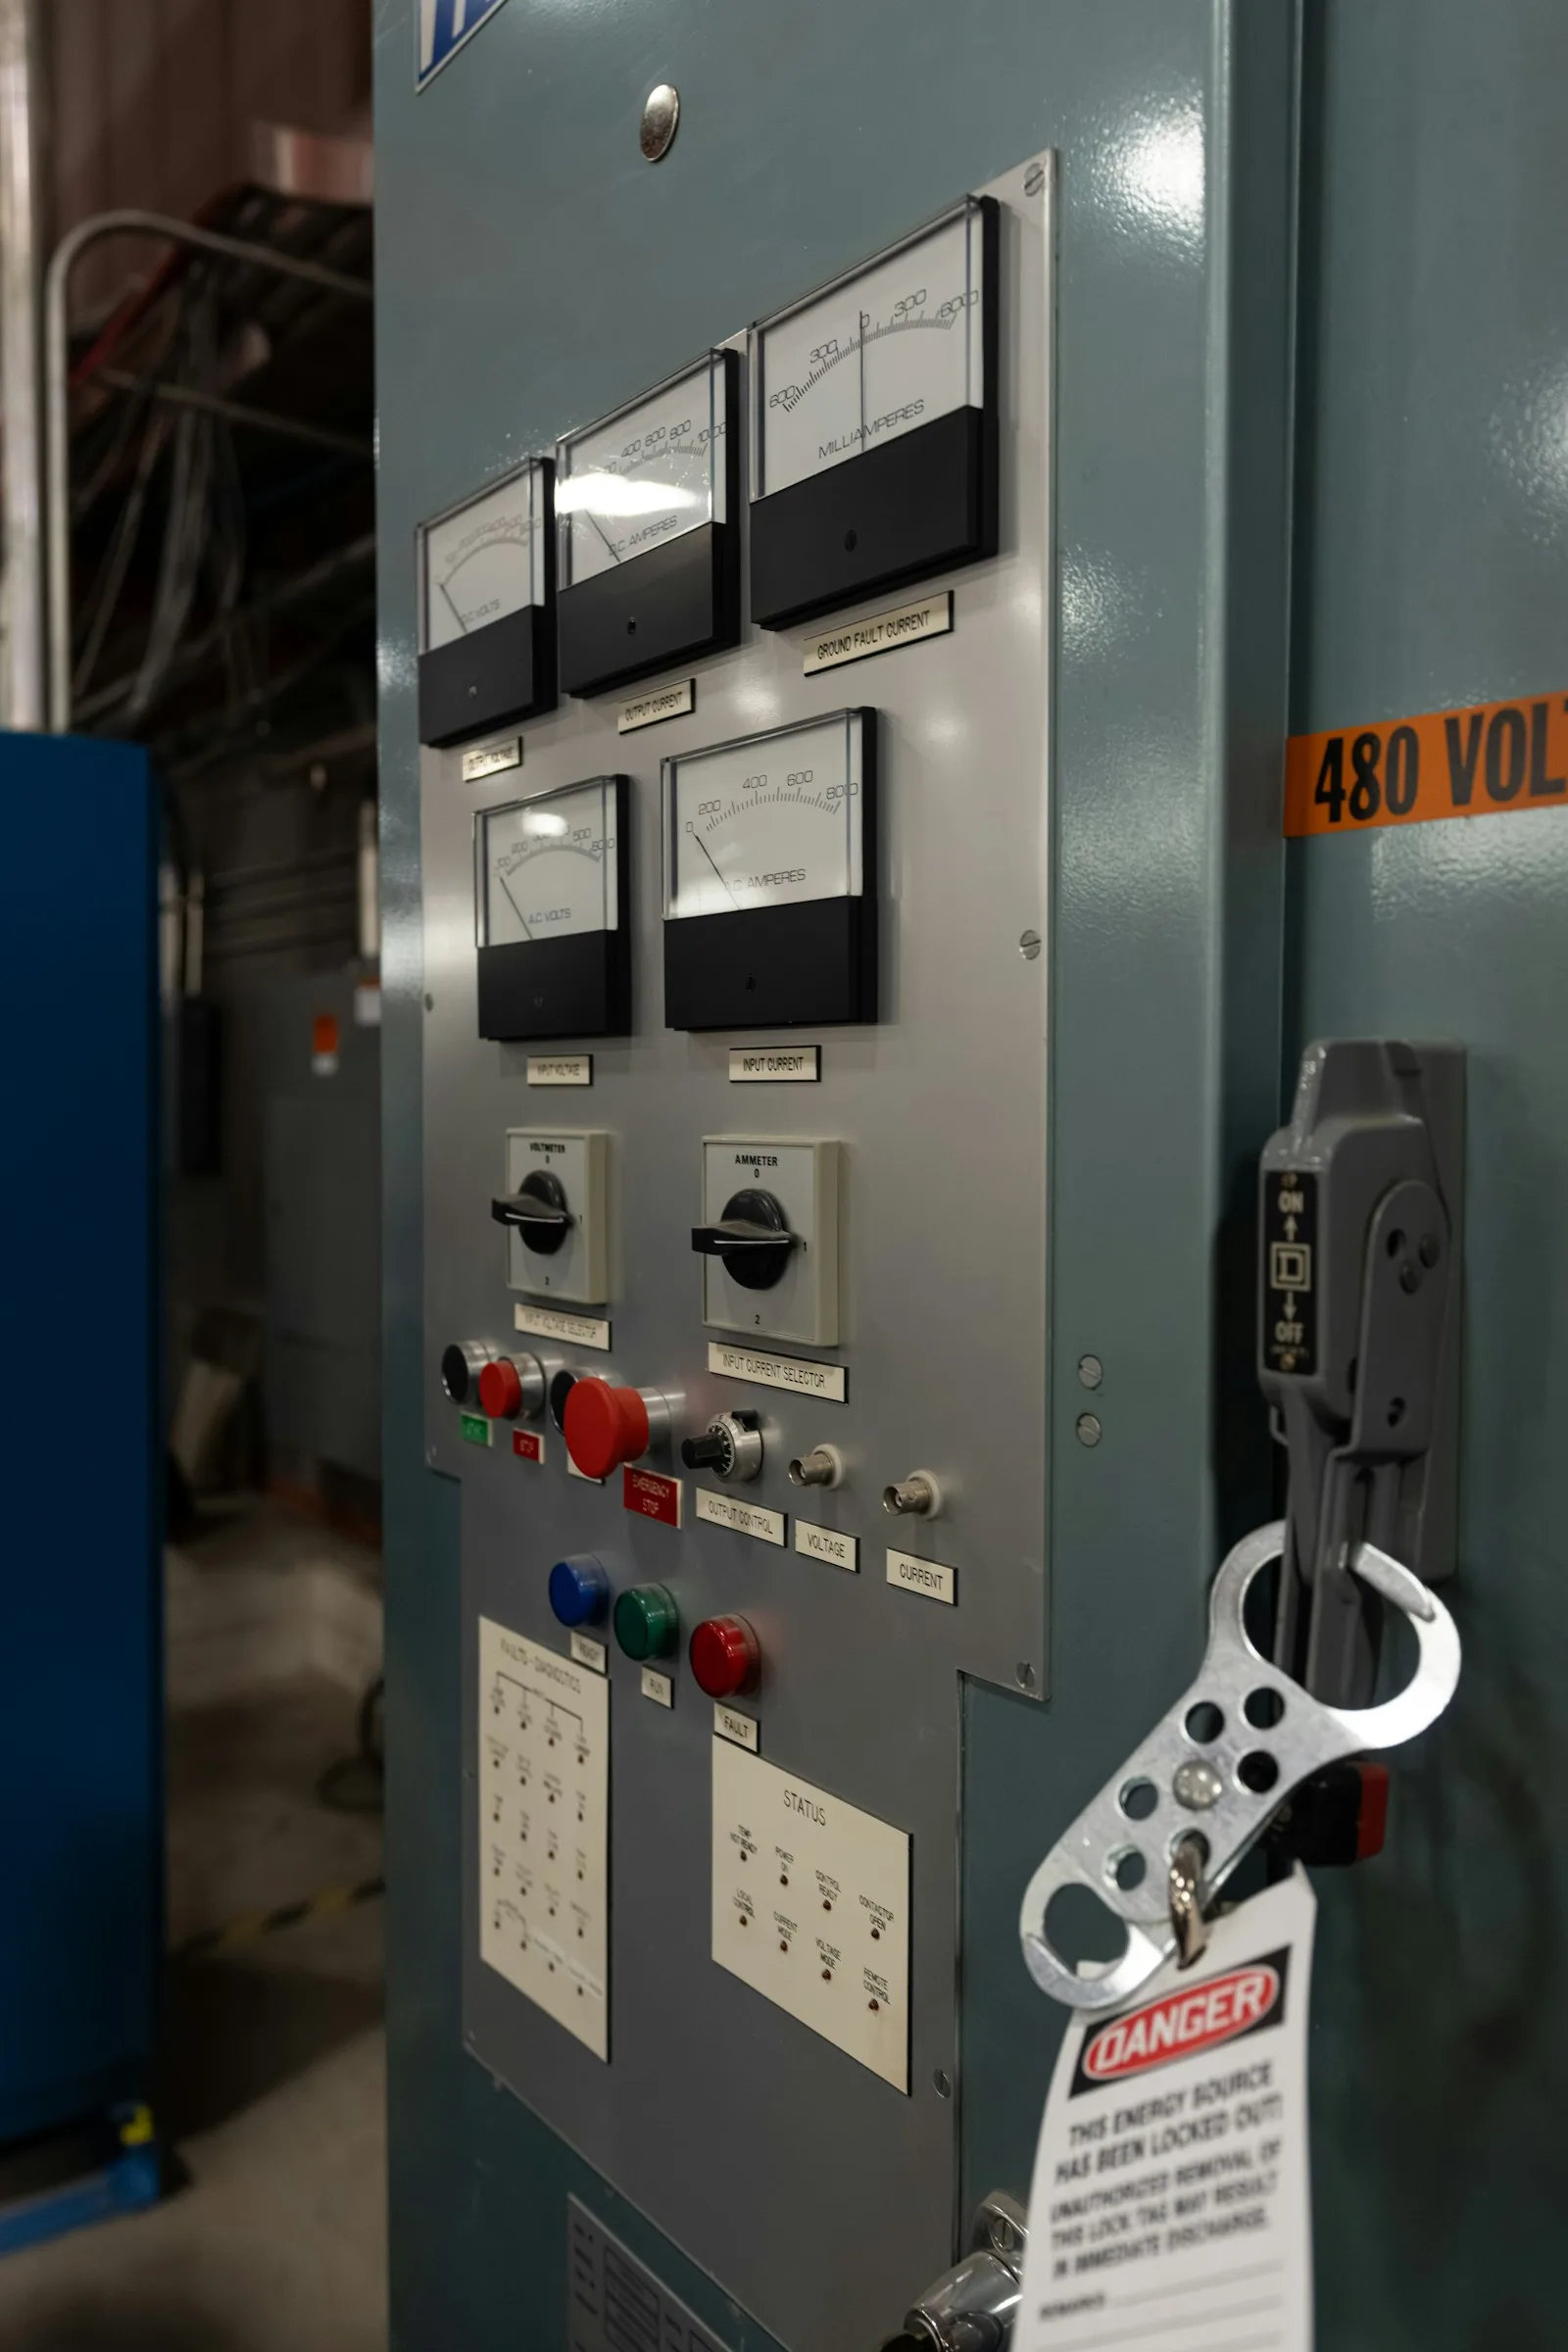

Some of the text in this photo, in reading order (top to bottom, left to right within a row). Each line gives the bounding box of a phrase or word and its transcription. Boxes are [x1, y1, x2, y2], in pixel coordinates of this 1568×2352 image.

[894, 289, 927, 318] 300
[809, 339, 838, 364] 300
[768, 385, 796, 409] 600
[645, 426, 666, 447] 600
[669, 419, 692, 440] 800
[817, 399, 925, 459] MILLIAMPERES
[620, 439, 642, 458] 400
[816, 610, 930, 660] GROUND FAULT CURRENT
[625, 692, 683, 721] OUTPUT CURRENT
[1314, 698, 1568, 823] 480 VOL
[742, 774, 767, 790] 400
[787, 770, 813, 787] 600
[698, 800, 721, 815] 200
[686, 821, 694, 833] 0
[748, 868, 807, 888] AMPERES
[743, 1056, 805, 1072] INPUT CURRENT
[529, 1143, 565, 1153] VOLTMETER
[735, 1154, 778, 1167] AMMETER
[754, 1168, 760, 1179] 0
[1278, 1191, 1304, 1214] ON
[803, 1242, 808, 1252] 1
[755, 1314, 760, 1325] 2
[1275, 1321, 1304, 1345] OFF
[722, 1353, 826, 1389] INPUT CURRENT SELECTOR
[709, 1499, 773, 1535] OUTPUT CONTROL
[808, 1532, 846, 1559] VOLTAGE
[900, 1563, 944, 1592] CURRENT
[723, 1715, 749, 1739] FAULT
[784, 1789, 826, 1827] STATUS
[1094, 1972, 1266, 2074] DANGER
[1068, 2061, 1274, 2148] THIS ENERGY SOURCE
[1054, 2154, 1091, 2185] HAS
[1096, 2137, 1145, 2174] BEEN
[1151, 2110, 1229, 2158] LOCKED
